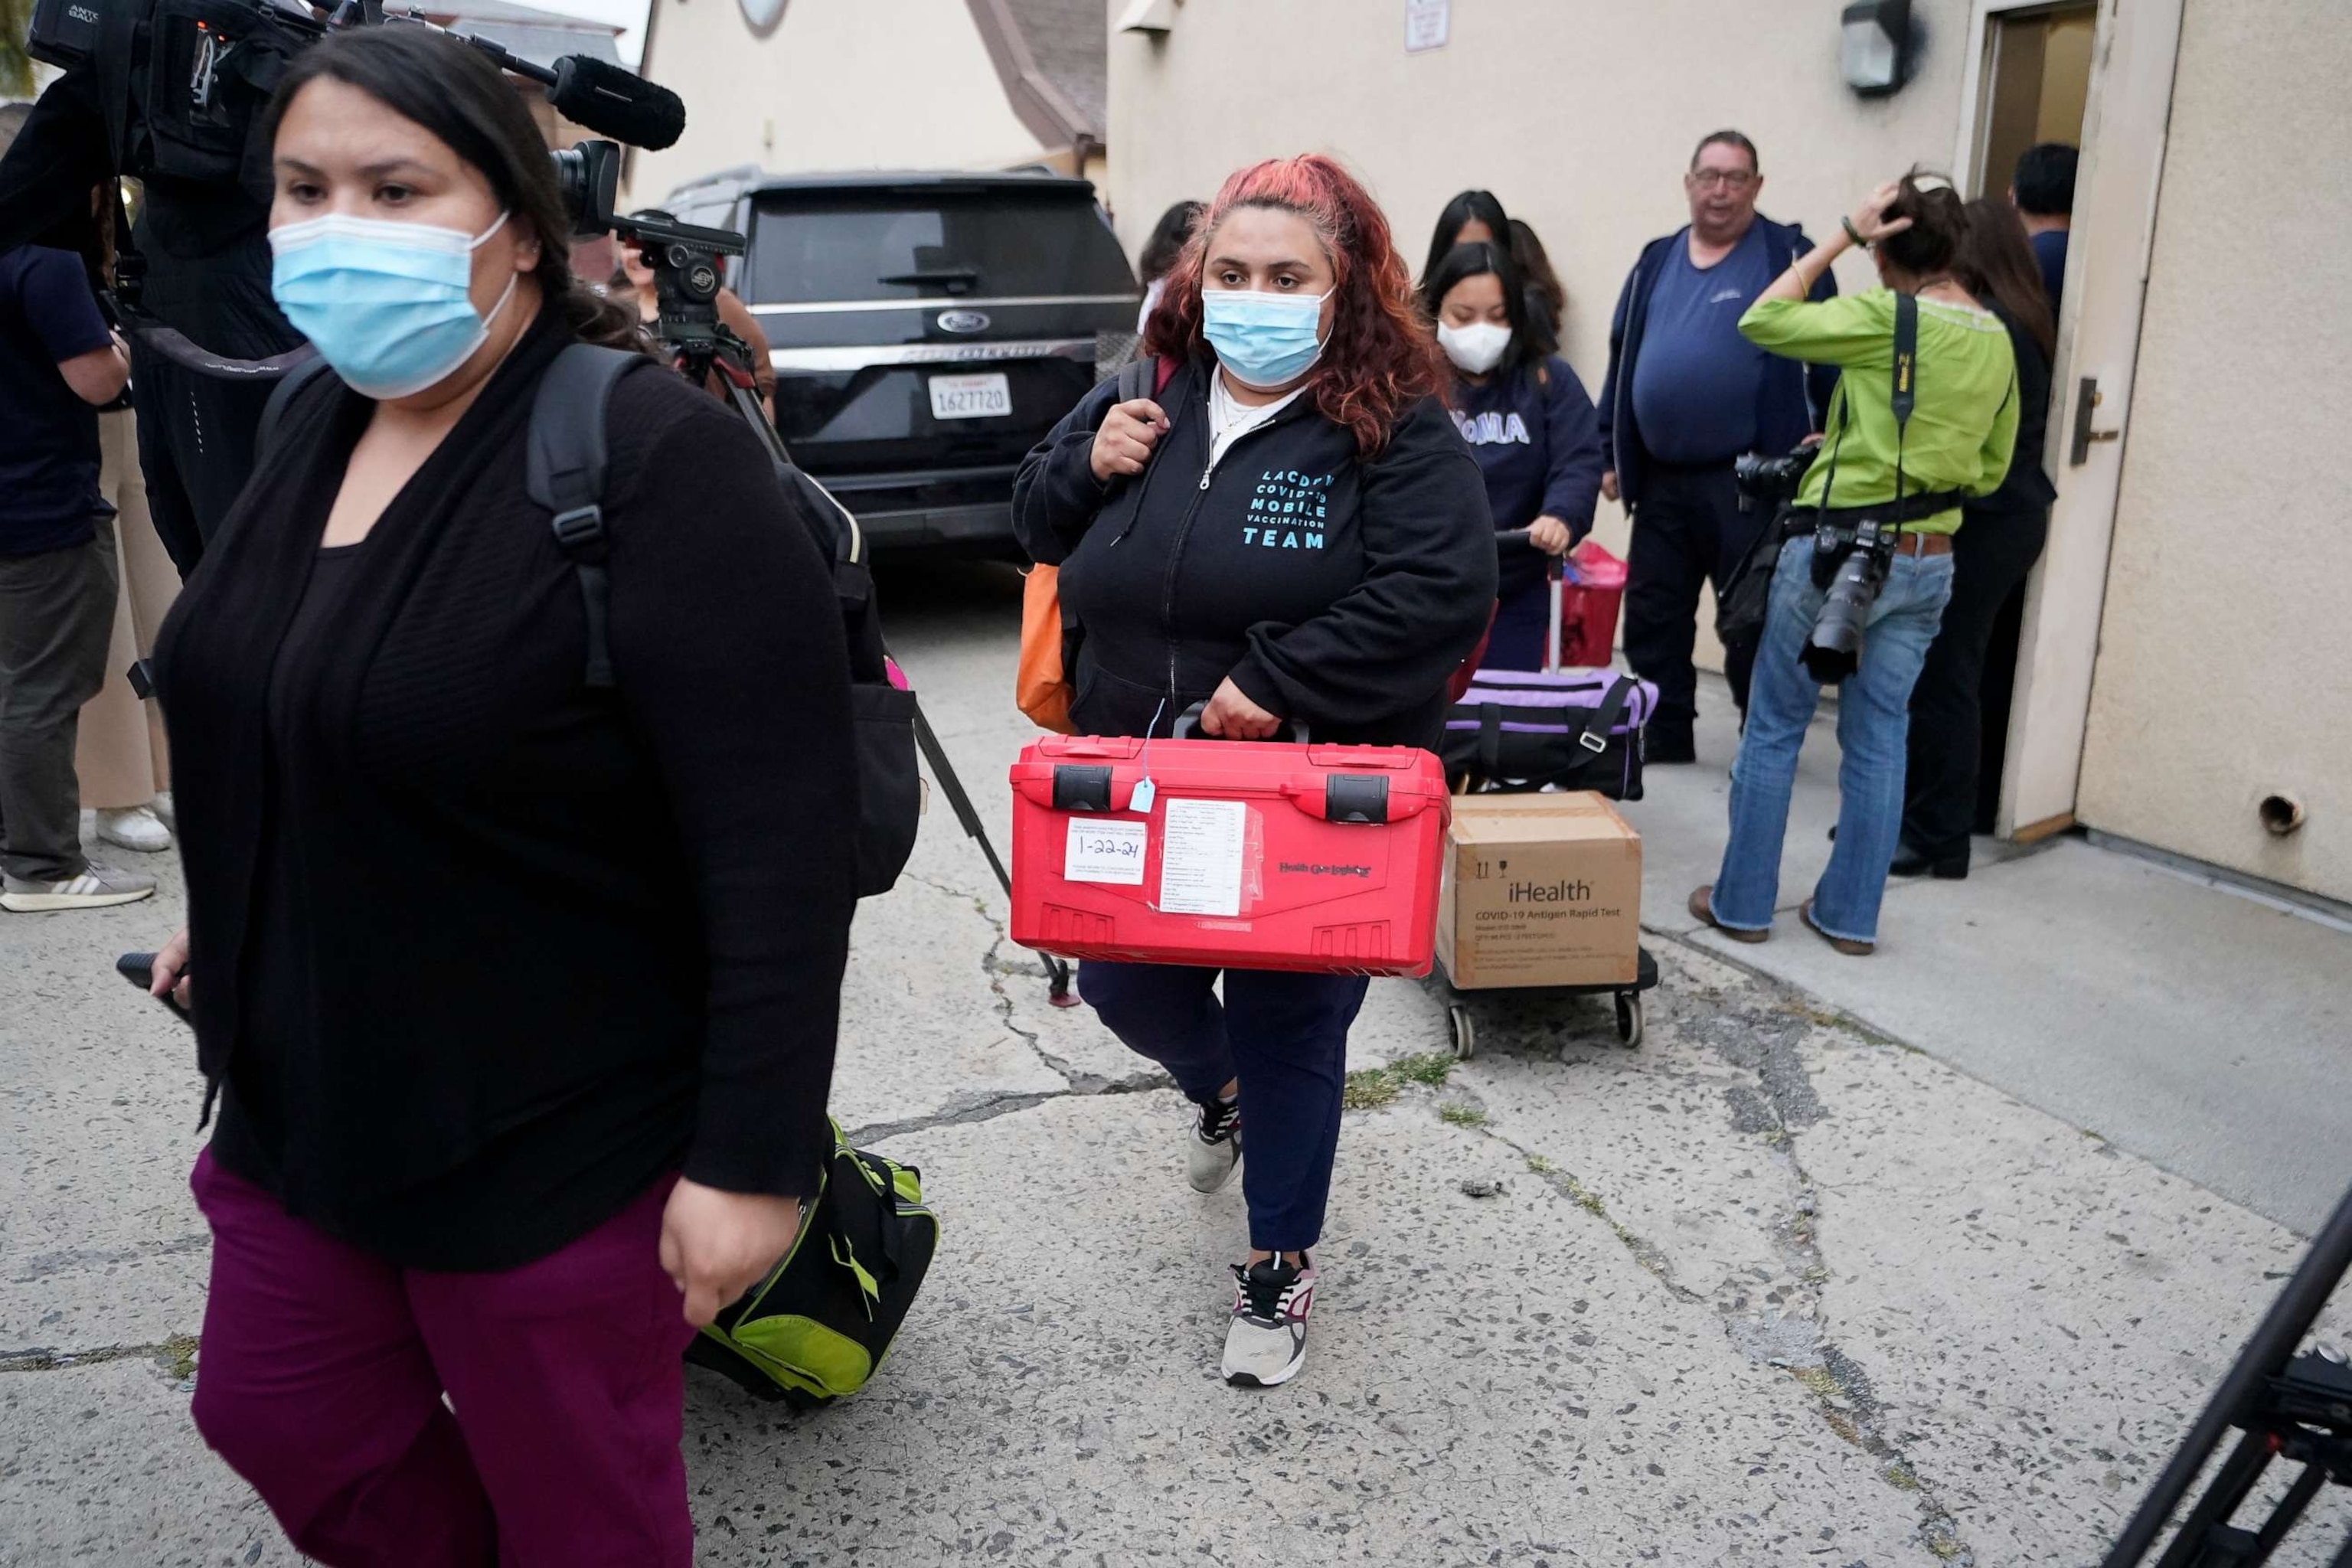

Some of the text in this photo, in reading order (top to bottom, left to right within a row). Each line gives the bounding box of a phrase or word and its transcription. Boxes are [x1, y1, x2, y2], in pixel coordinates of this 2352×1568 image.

[1448, 410, 1530, 446] OMA
[1256, 484, 1326, 503] COVID-19
[1250, 498, 1325, 518] MOBILE
[1247, 514, 1324, 529] VACCINATION
[1243, 527, 1323, 549] TEAM
[1080, 835, 1138, 858] 1-22-24
[1509, 880, 1590, 903] iHealth
[1475, 908, 1620, 921] COVID-19 Antigen Rapid Test
